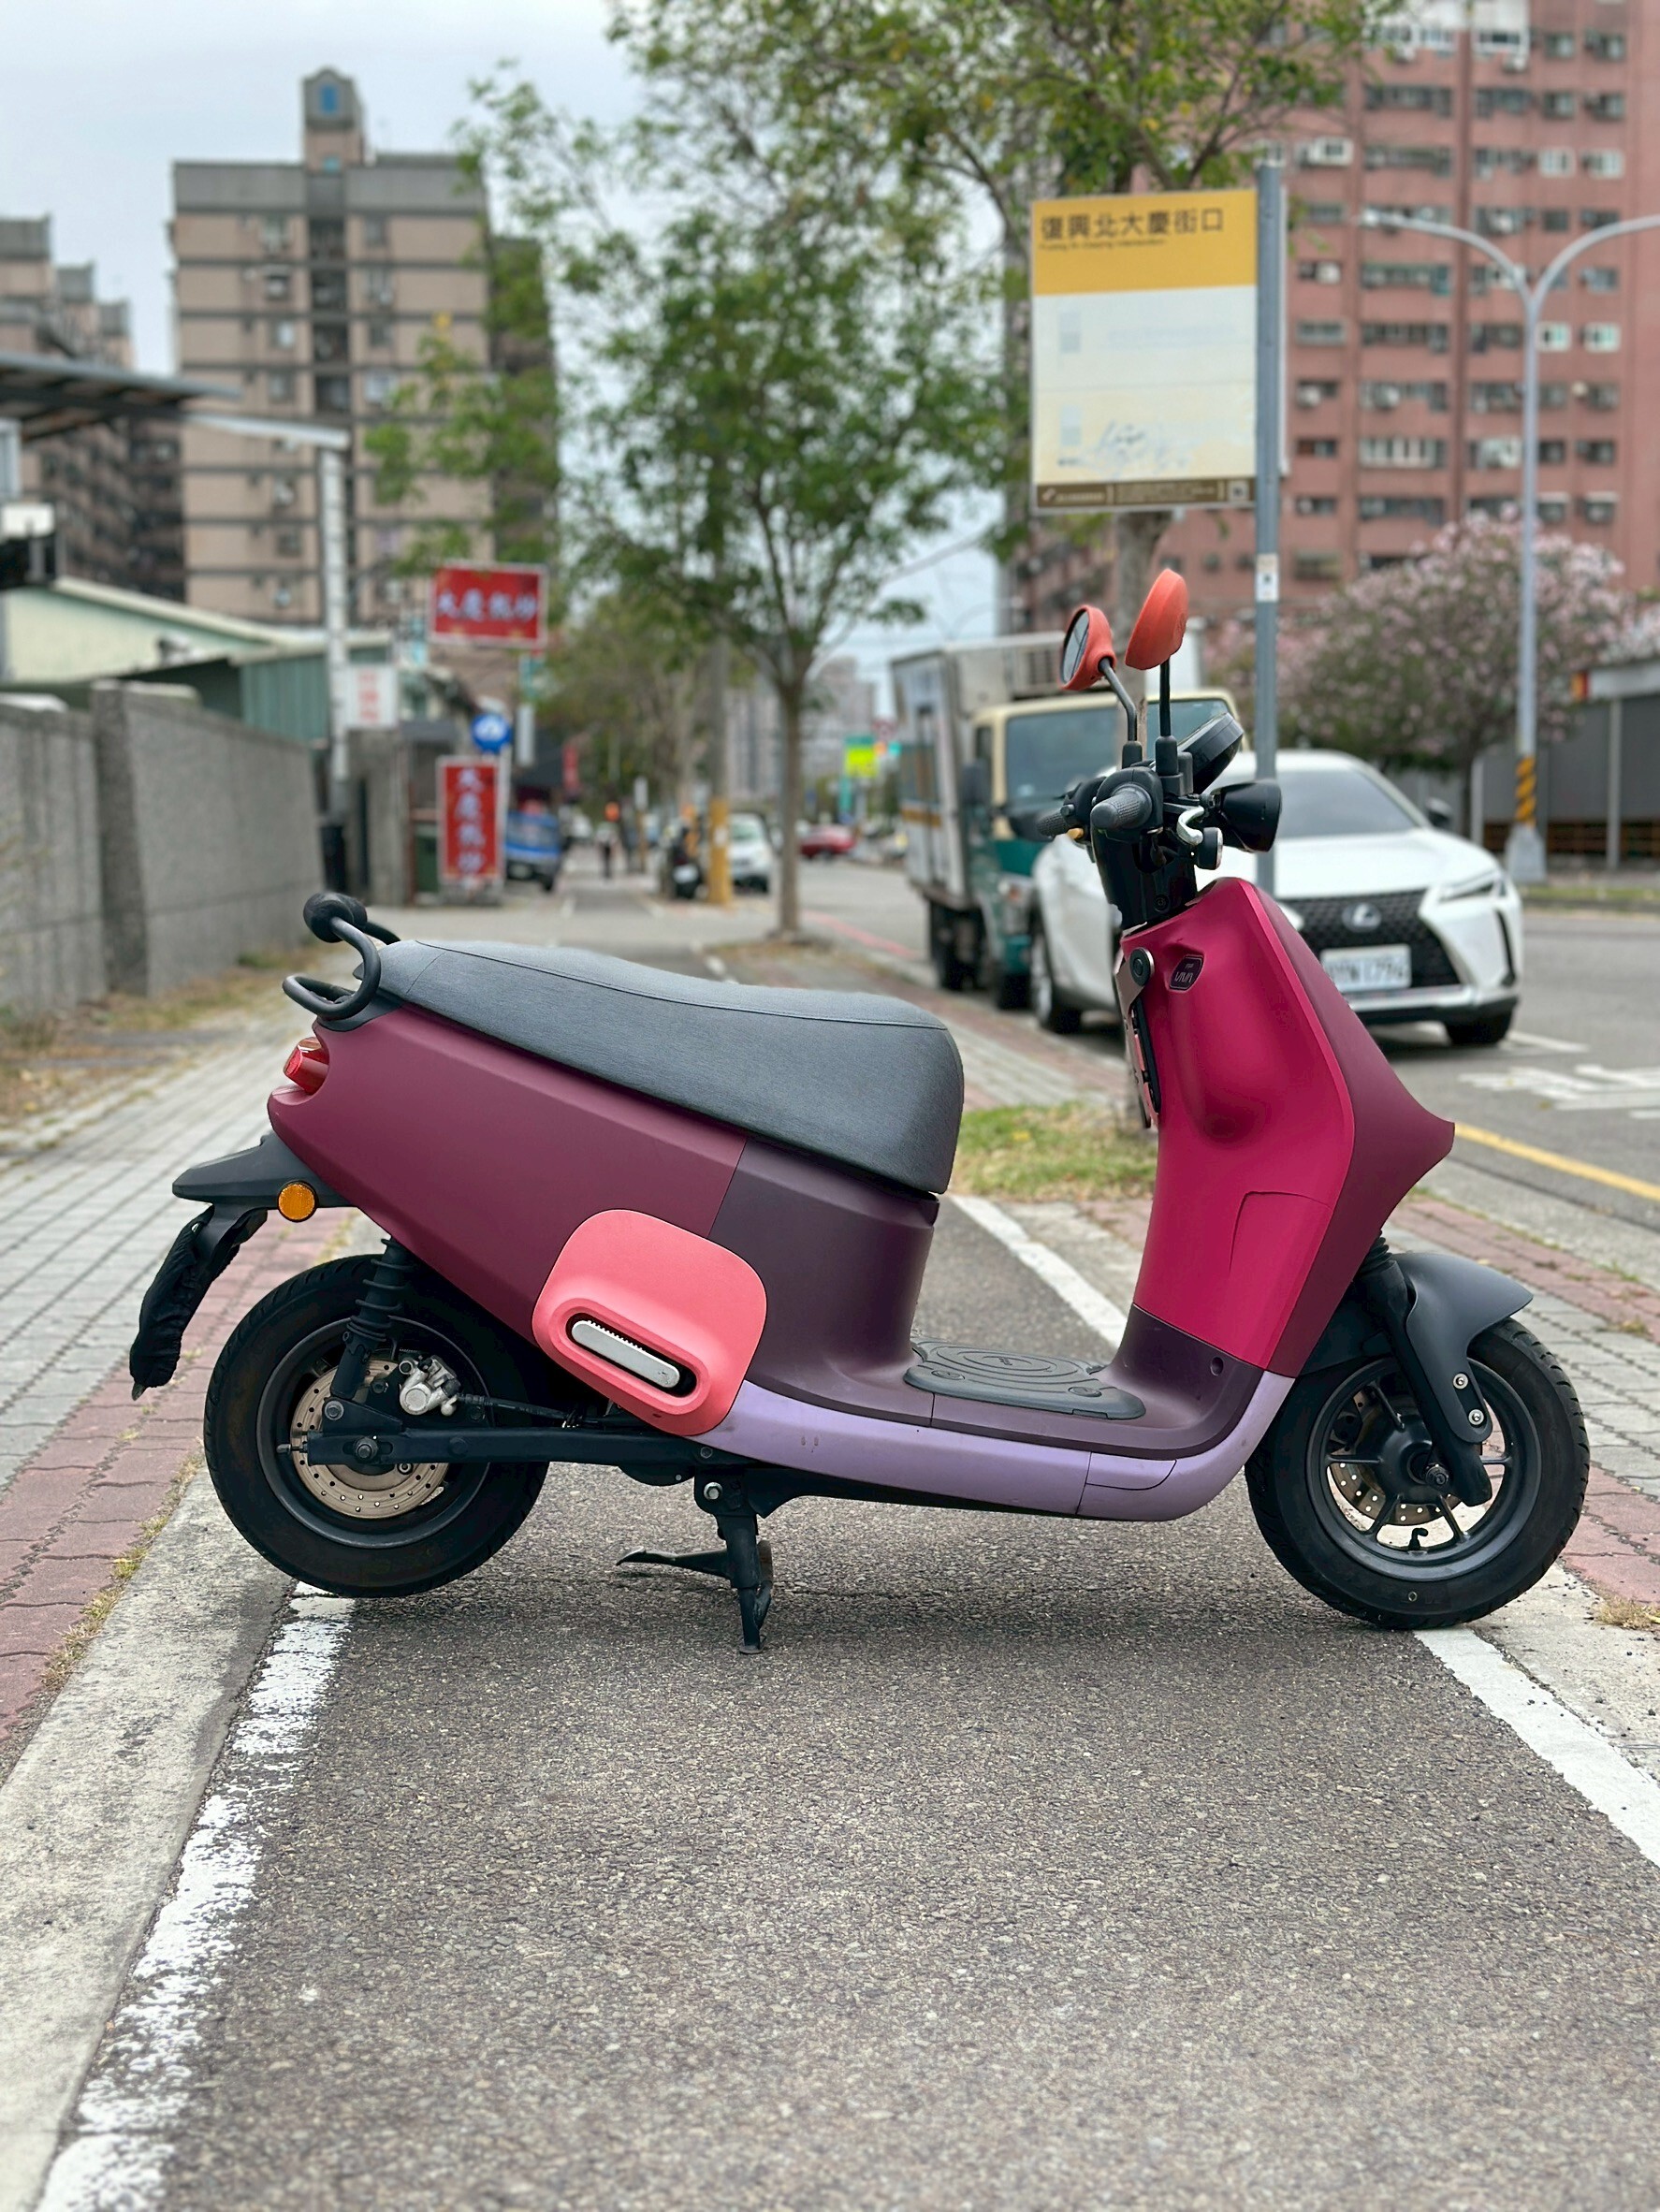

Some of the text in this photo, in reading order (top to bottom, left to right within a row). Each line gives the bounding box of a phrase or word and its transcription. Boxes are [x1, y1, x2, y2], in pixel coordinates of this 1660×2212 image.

[1041, 207, 1224, 240] 復興北大慶街口
